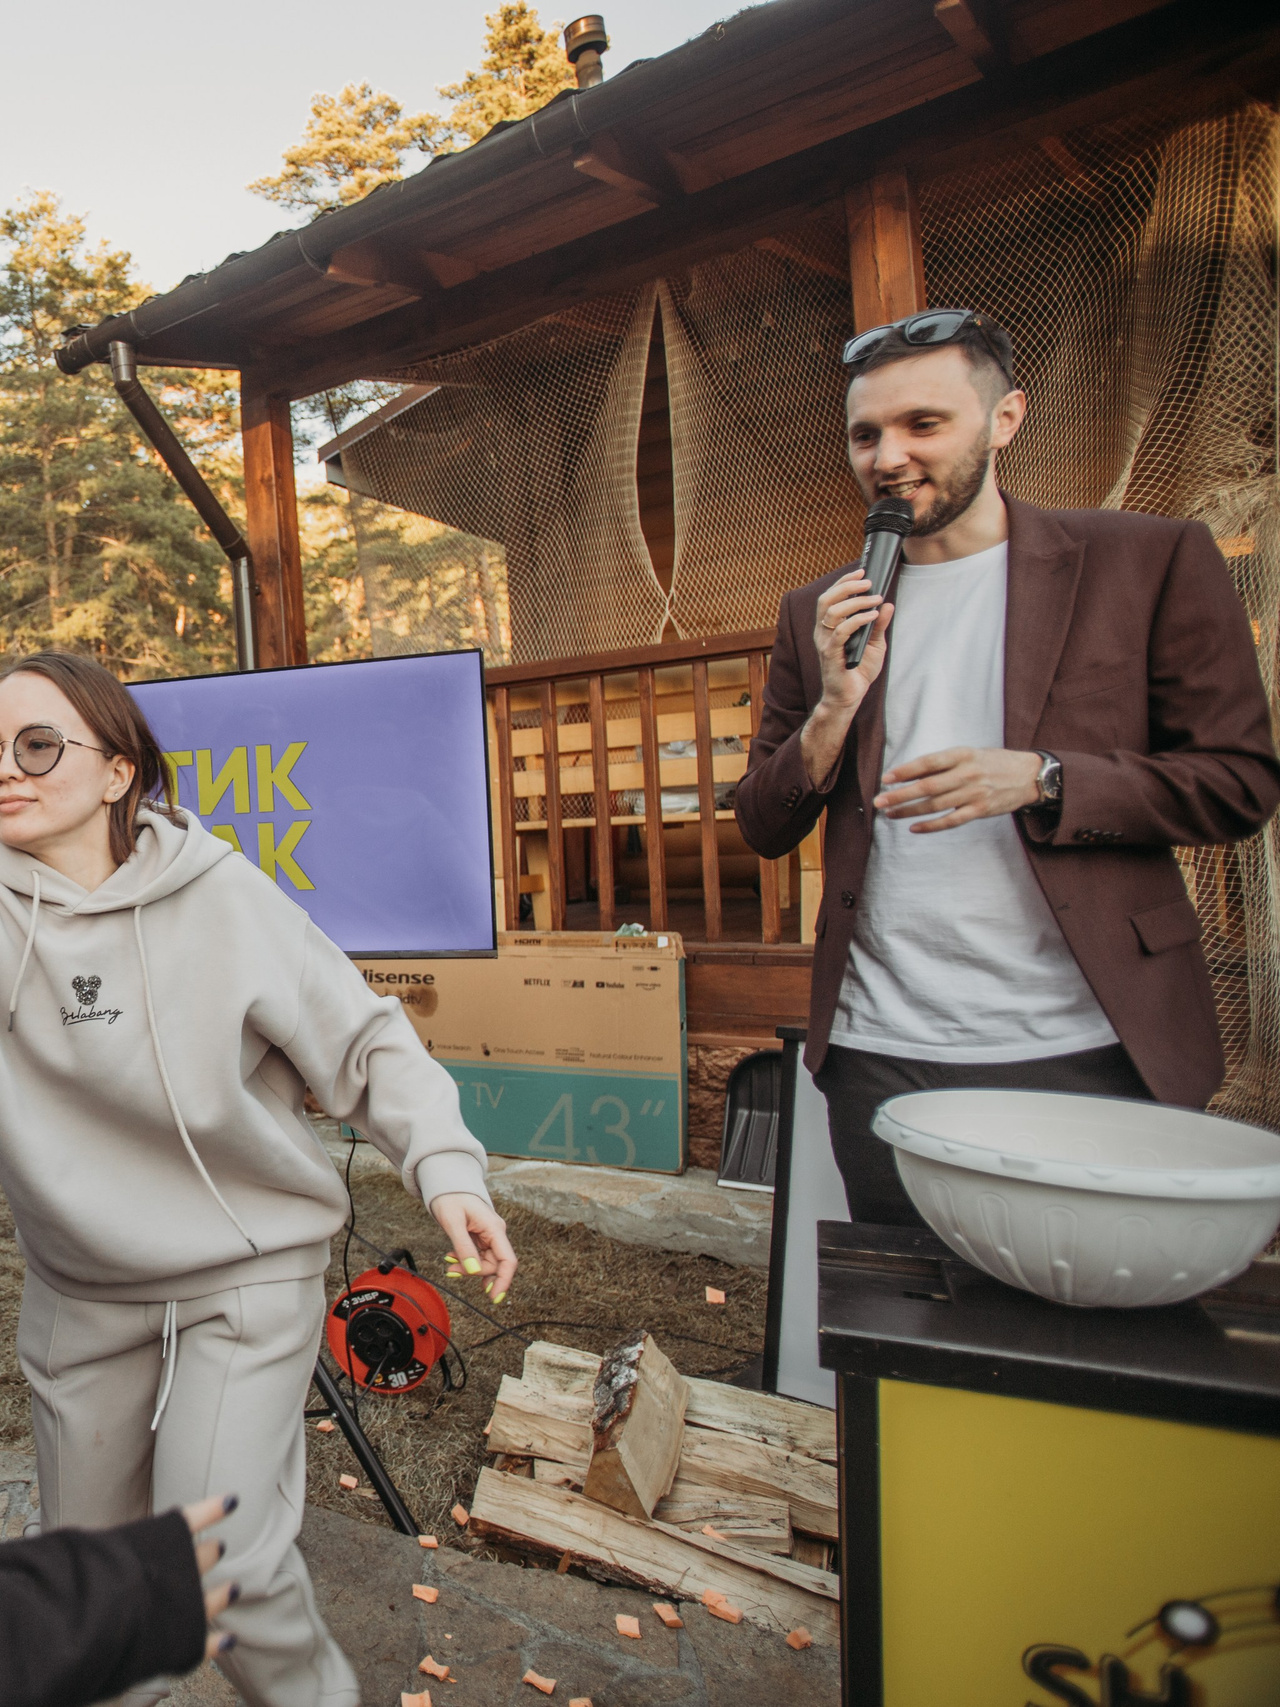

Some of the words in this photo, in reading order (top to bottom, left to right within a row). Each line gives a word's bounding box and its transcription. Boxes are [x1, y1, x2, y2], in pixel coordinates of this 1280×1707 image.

[157, 741, 313, 816] ТИК
[524, 978, 551, 987] NETFLIX
[470, 1082, 505, 1109] TV
[388, 1371, 408, 1388] 30
